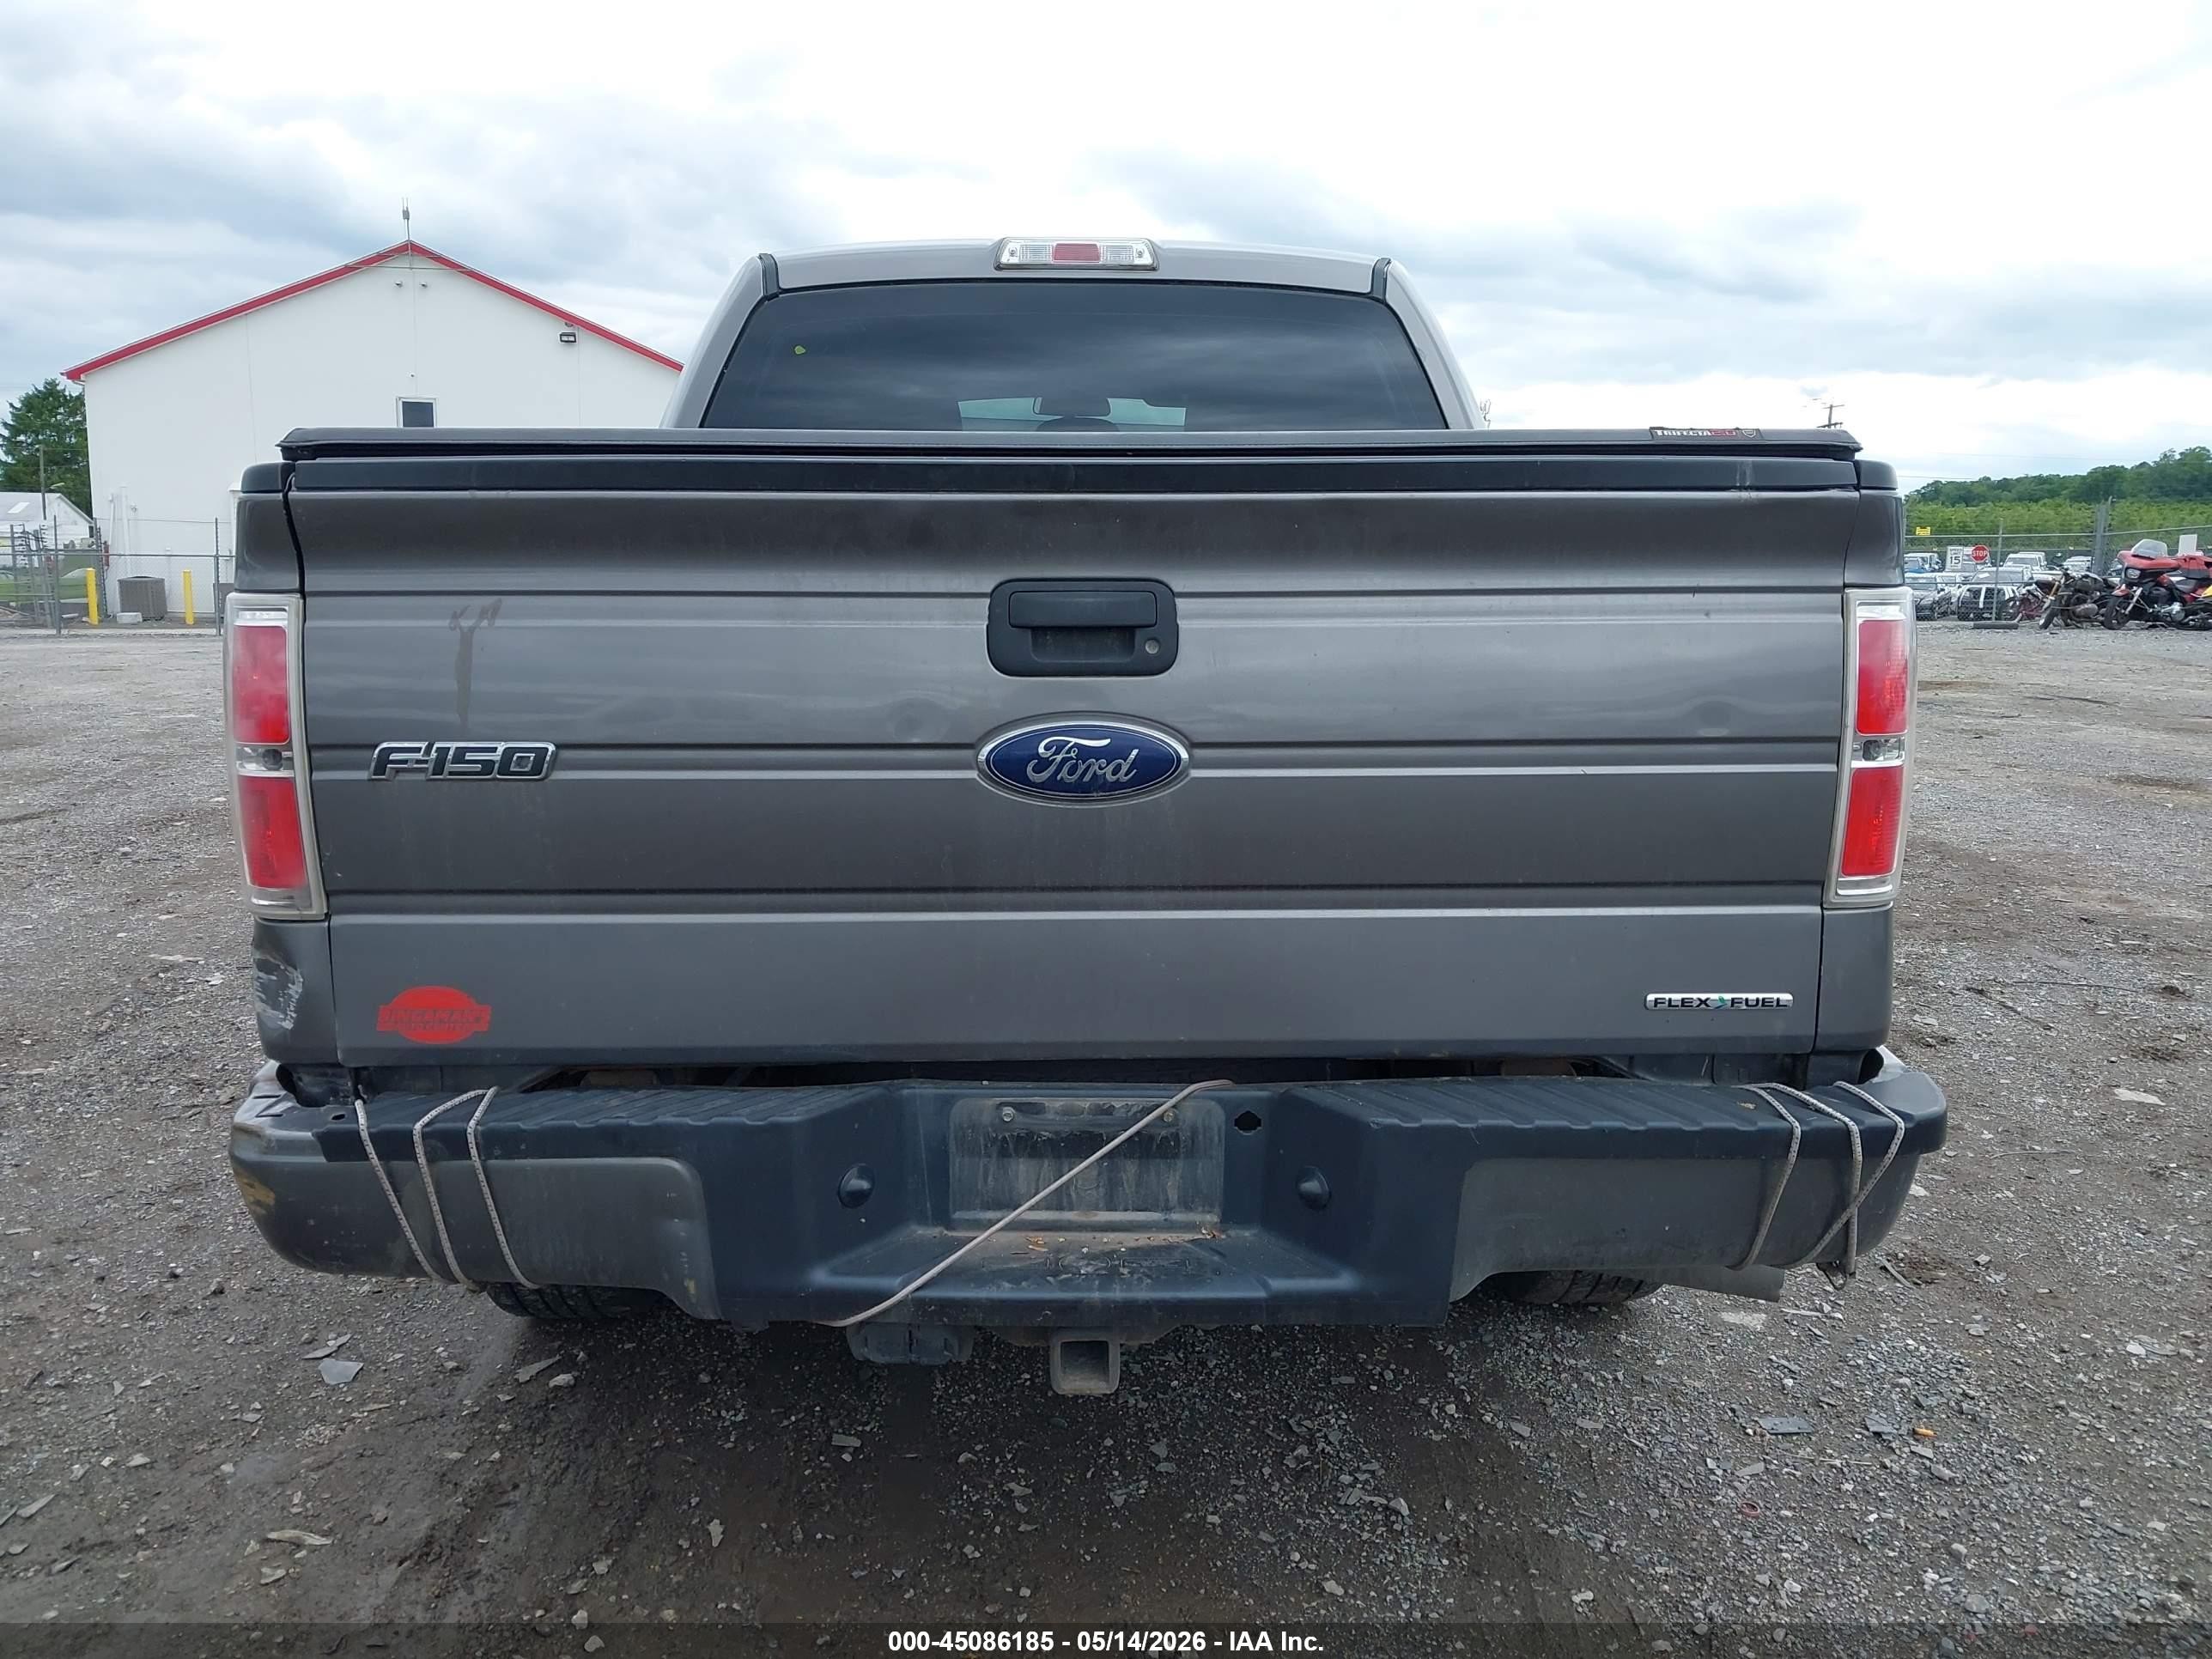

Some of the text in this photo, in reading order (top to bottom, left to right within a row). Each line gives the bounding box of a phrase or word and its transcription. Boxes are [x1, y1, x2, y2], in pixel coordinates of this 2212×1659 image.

[1026, 736, 1139, 783] Ford
[1653, 997, 1790, 1008] FLEX FUEL
